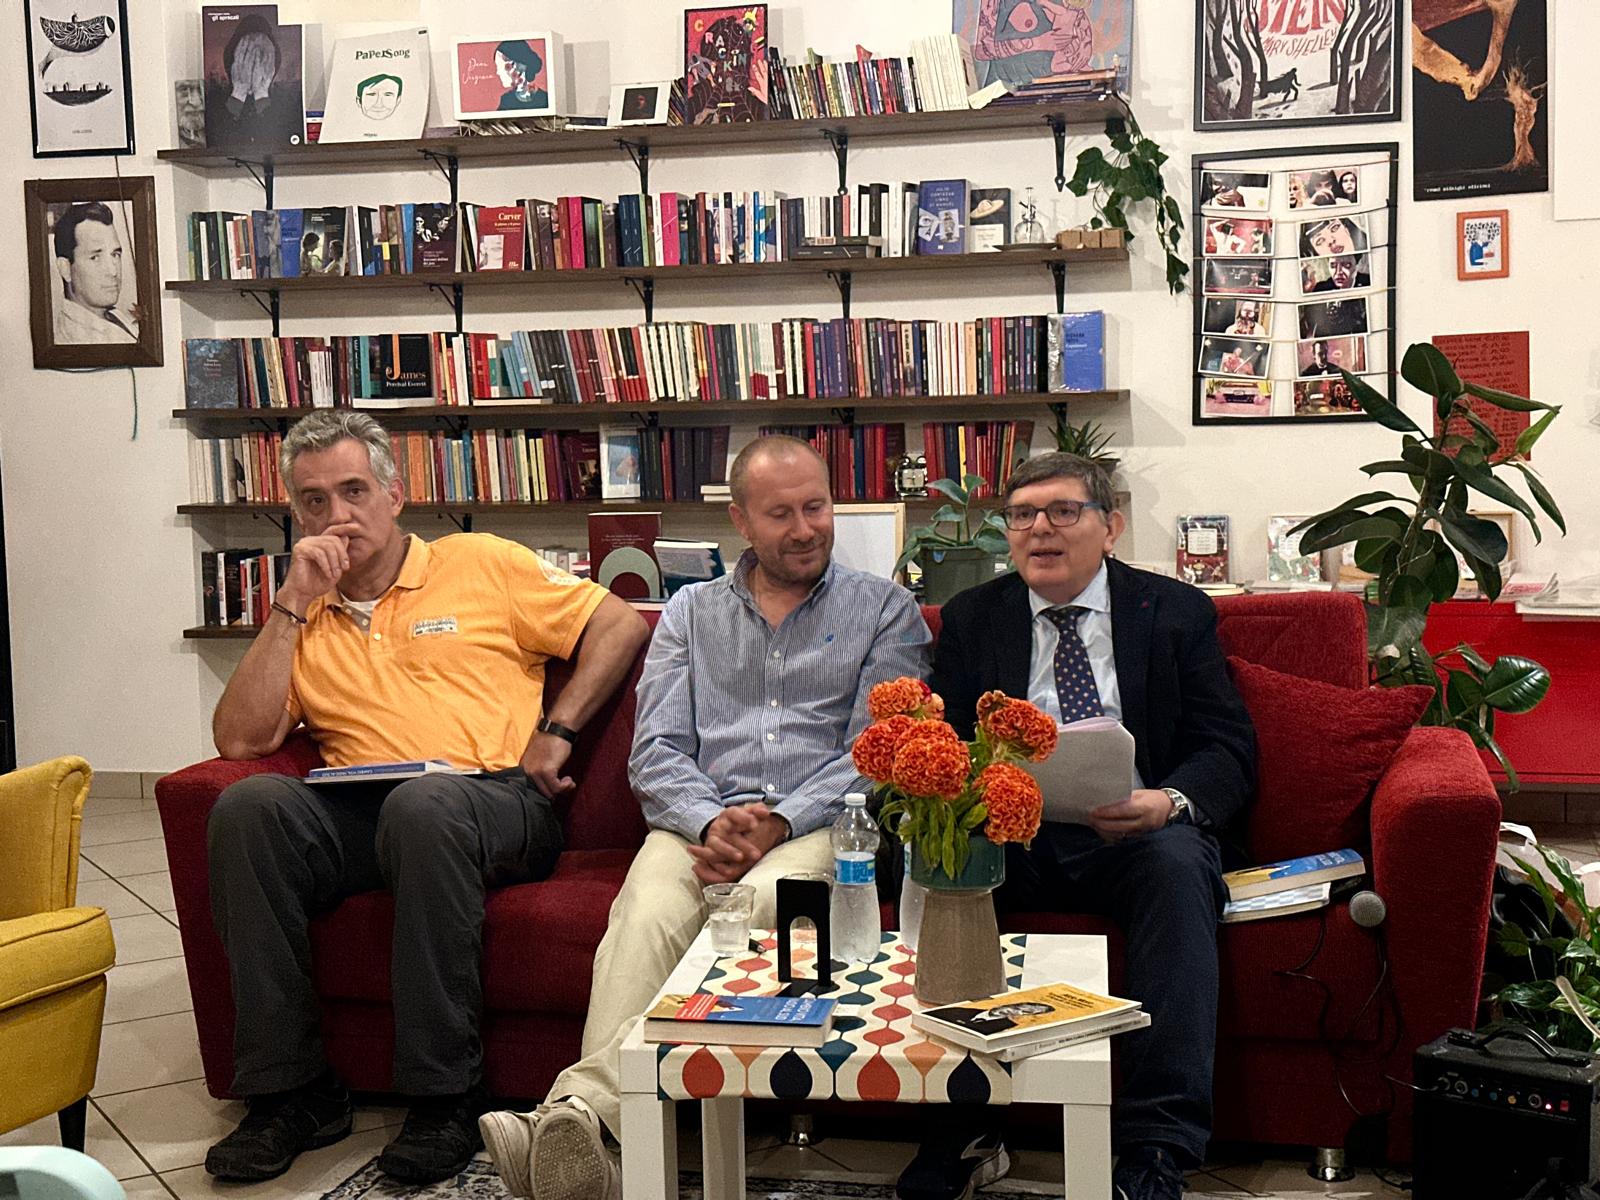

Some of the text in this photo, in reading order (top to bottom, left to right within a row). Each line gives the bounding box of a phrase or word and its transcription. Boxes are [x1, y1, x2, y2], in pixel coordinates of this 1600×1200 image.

[1286, 28, 1338, 59] SHELLEY
[498, 212, 522, 221] Carver
[385, 334, 427, 381] James
